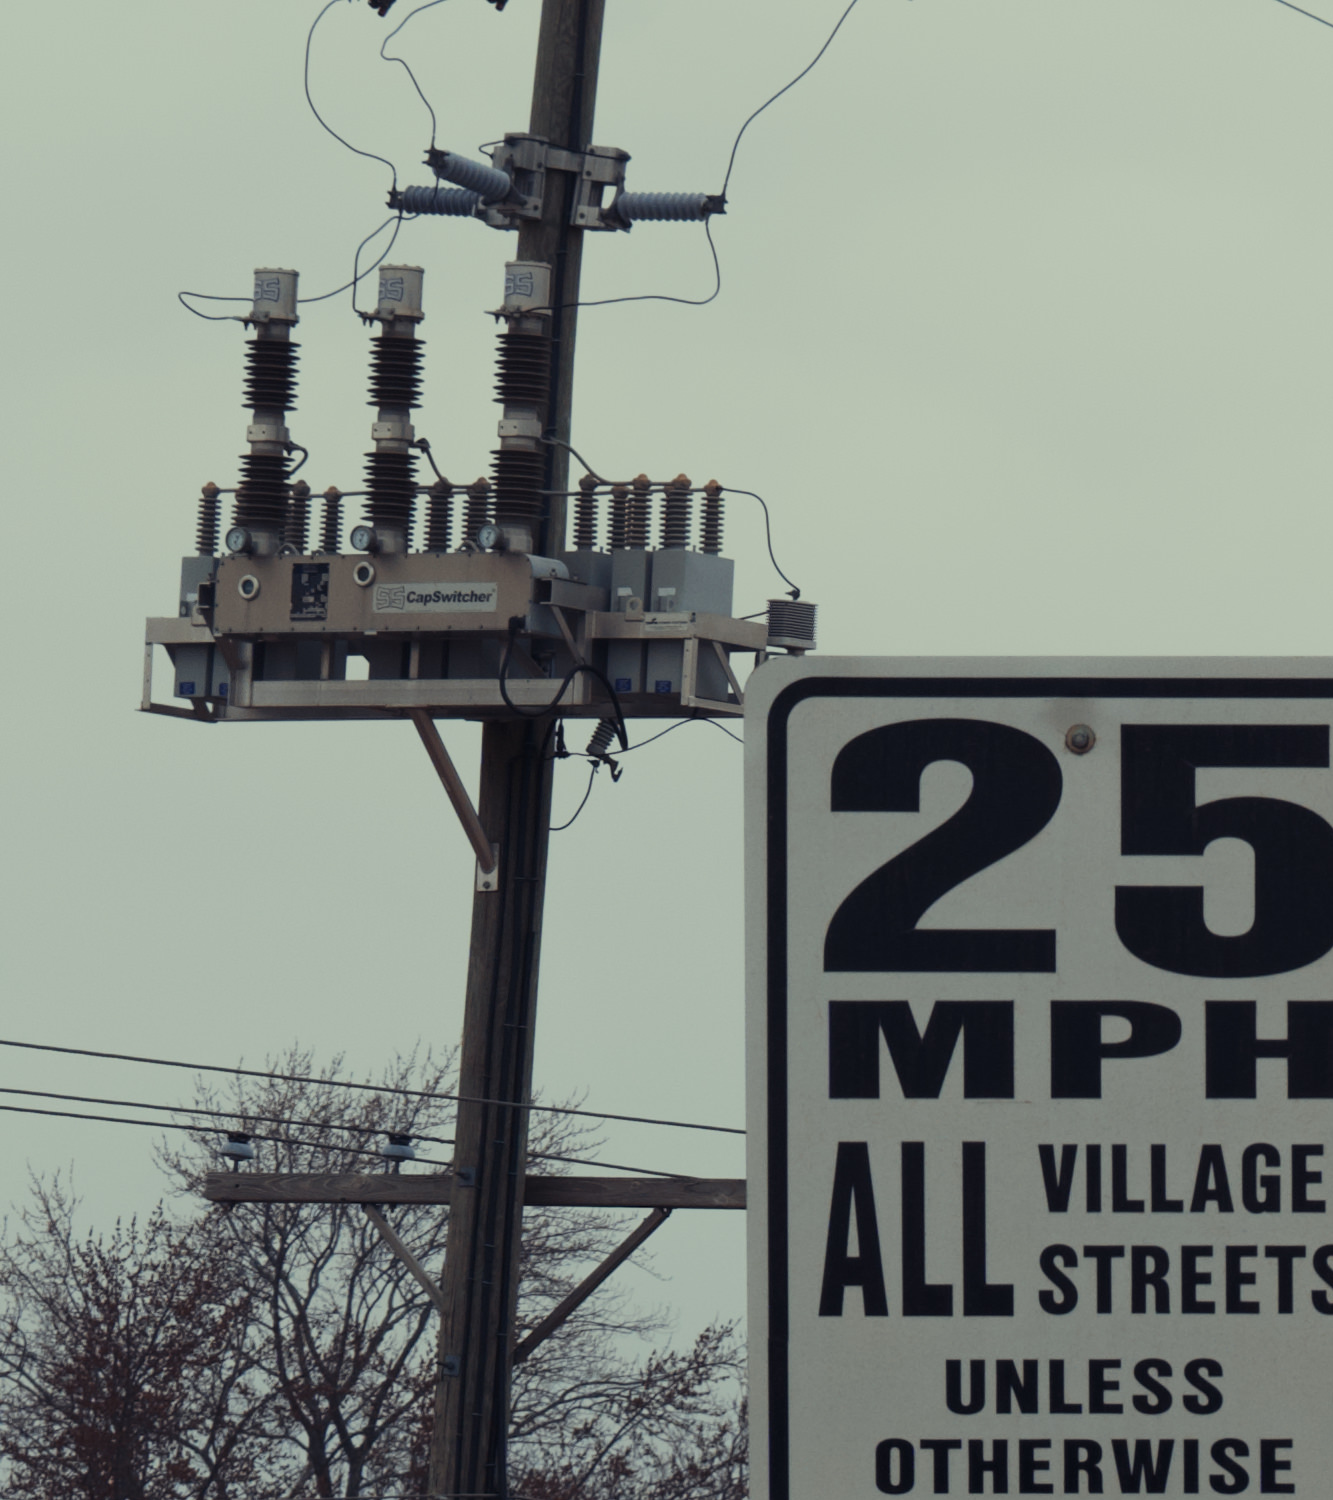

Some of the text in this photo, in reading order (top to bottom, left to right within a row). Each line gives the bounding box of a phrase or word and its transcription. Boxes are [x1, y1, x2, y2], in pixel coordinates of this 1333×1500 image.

[406, 590, 493, 606] CapSwitcher
[818, 1141, 1326, 1317] ALL VILLAGE
[945, 1358, 1224, 1416] UNLESS
[874, 1437, 1295, 1495] OTHERWISE
